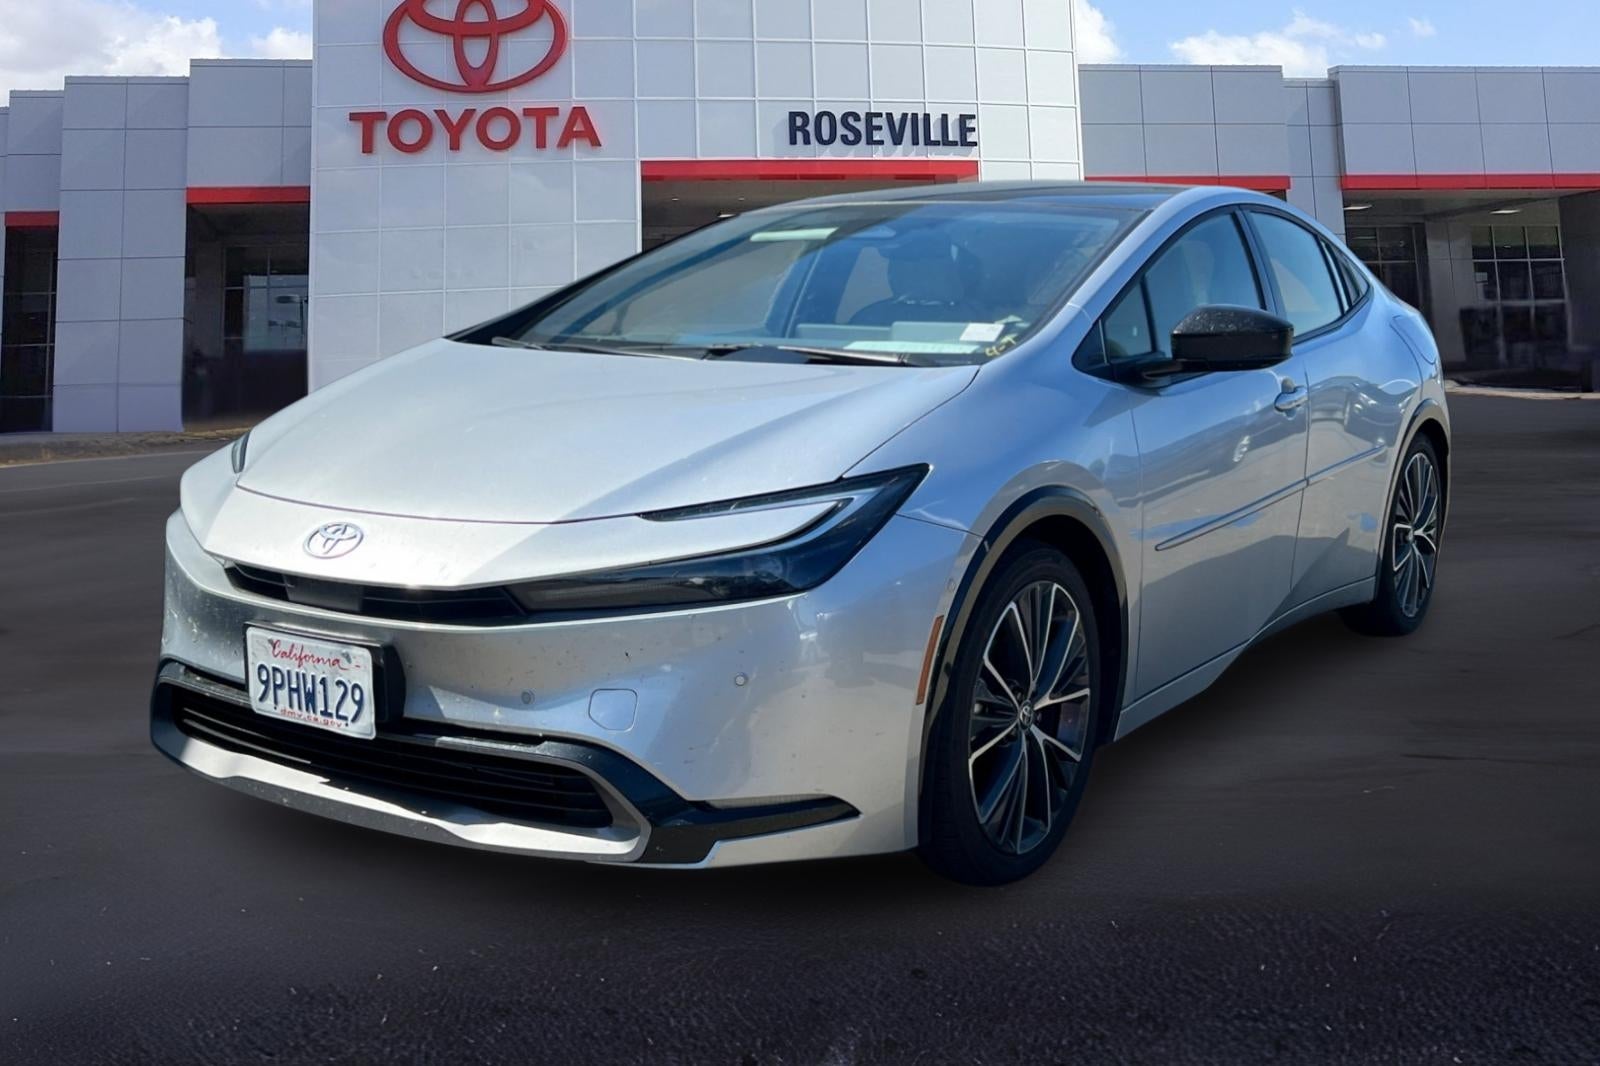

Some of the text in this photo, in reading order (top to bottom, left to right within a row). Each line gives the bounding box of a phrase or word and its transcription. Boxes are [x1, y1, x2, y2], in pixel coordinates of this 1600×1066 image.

[349, 106, 602, 154] TOYOTA
[788, 111, 978, 147] ROSEVILLE
[272, 639, 349, 671] California
[257, 663, 364, 723] 9PHW129
[280, 708, 343, 728] dmv.ca.gov
